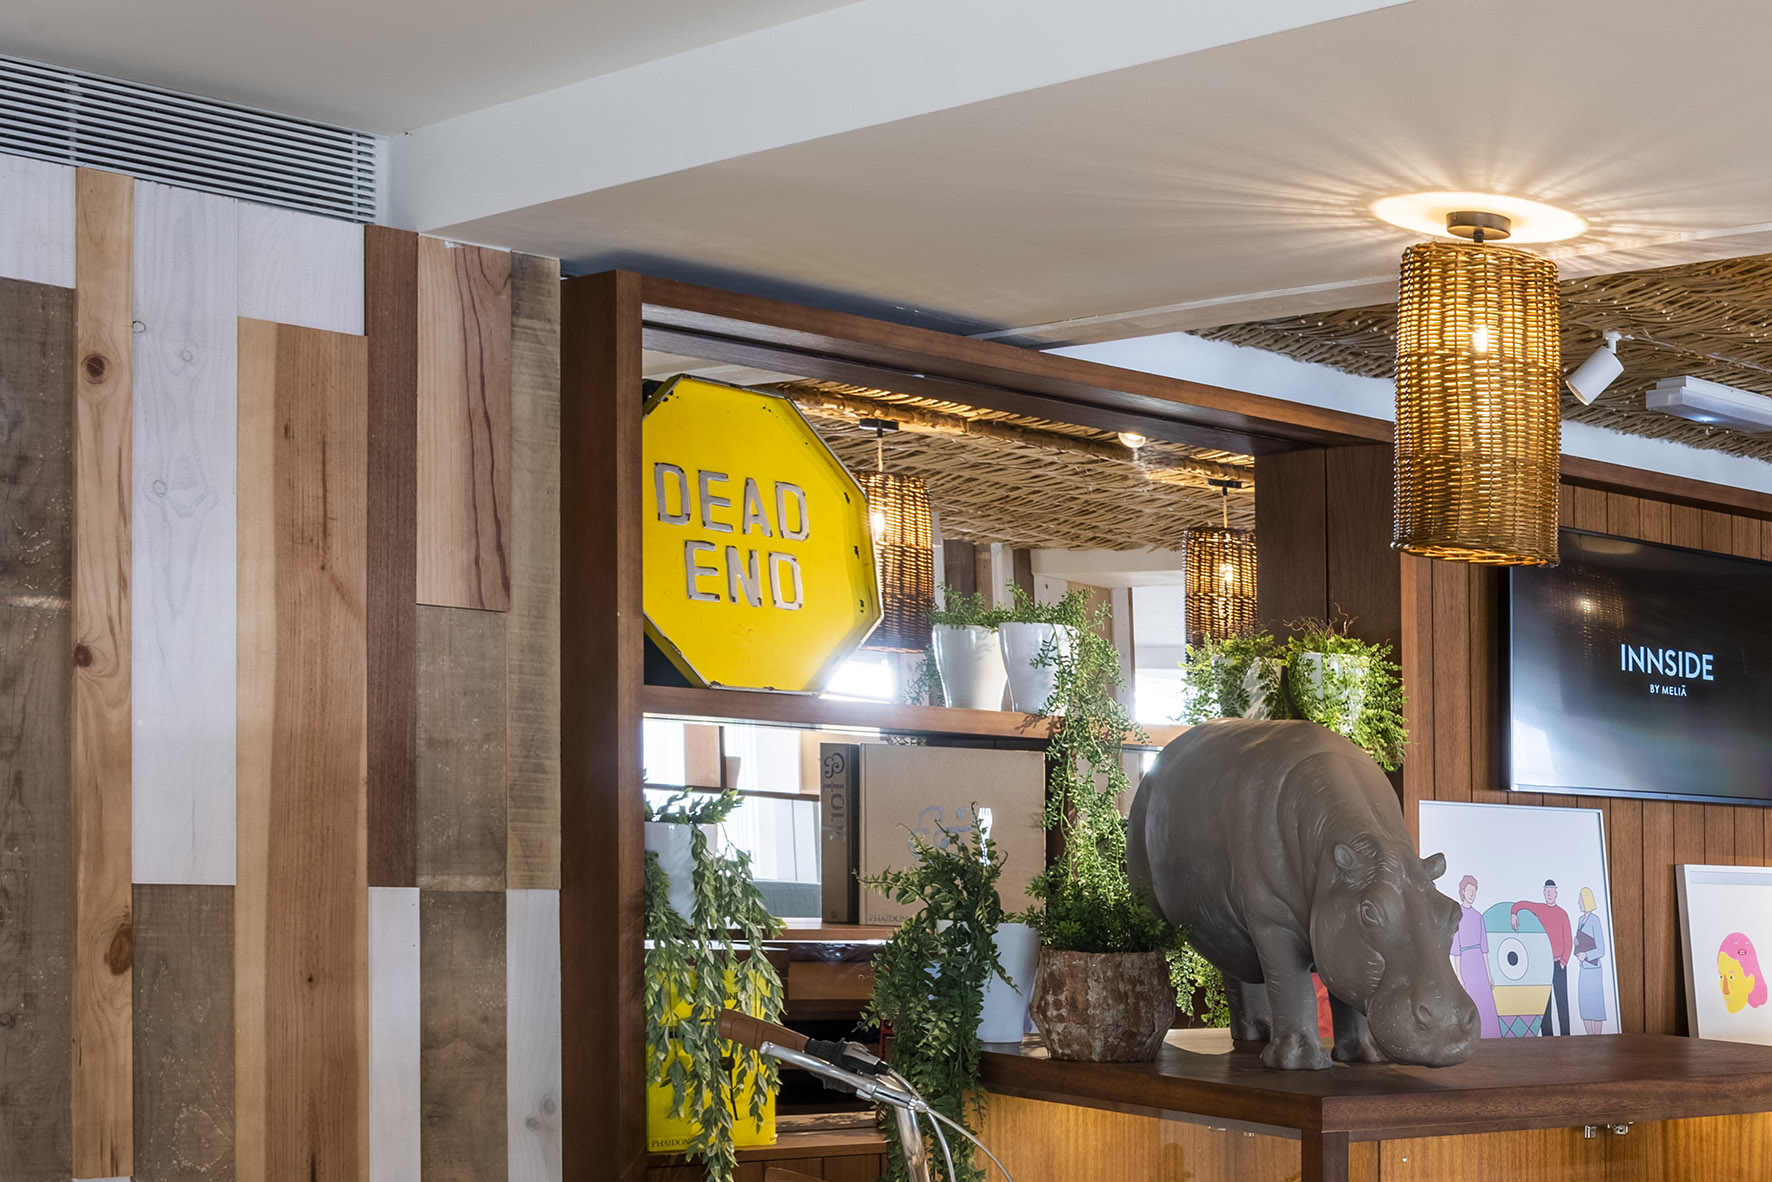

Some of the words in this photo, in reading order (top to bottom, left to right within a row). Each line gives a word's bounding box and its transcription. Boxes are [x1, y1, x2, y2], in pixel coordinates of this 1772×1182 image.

[653, 461, 810, 541] DEAD
[684, 539, 803, 611] END
[1620, 643, 1715, 681] INNSIDE
[1649, 683, 1660, 694] BY
[651, 1136, 691, 1149] PHAIDON
